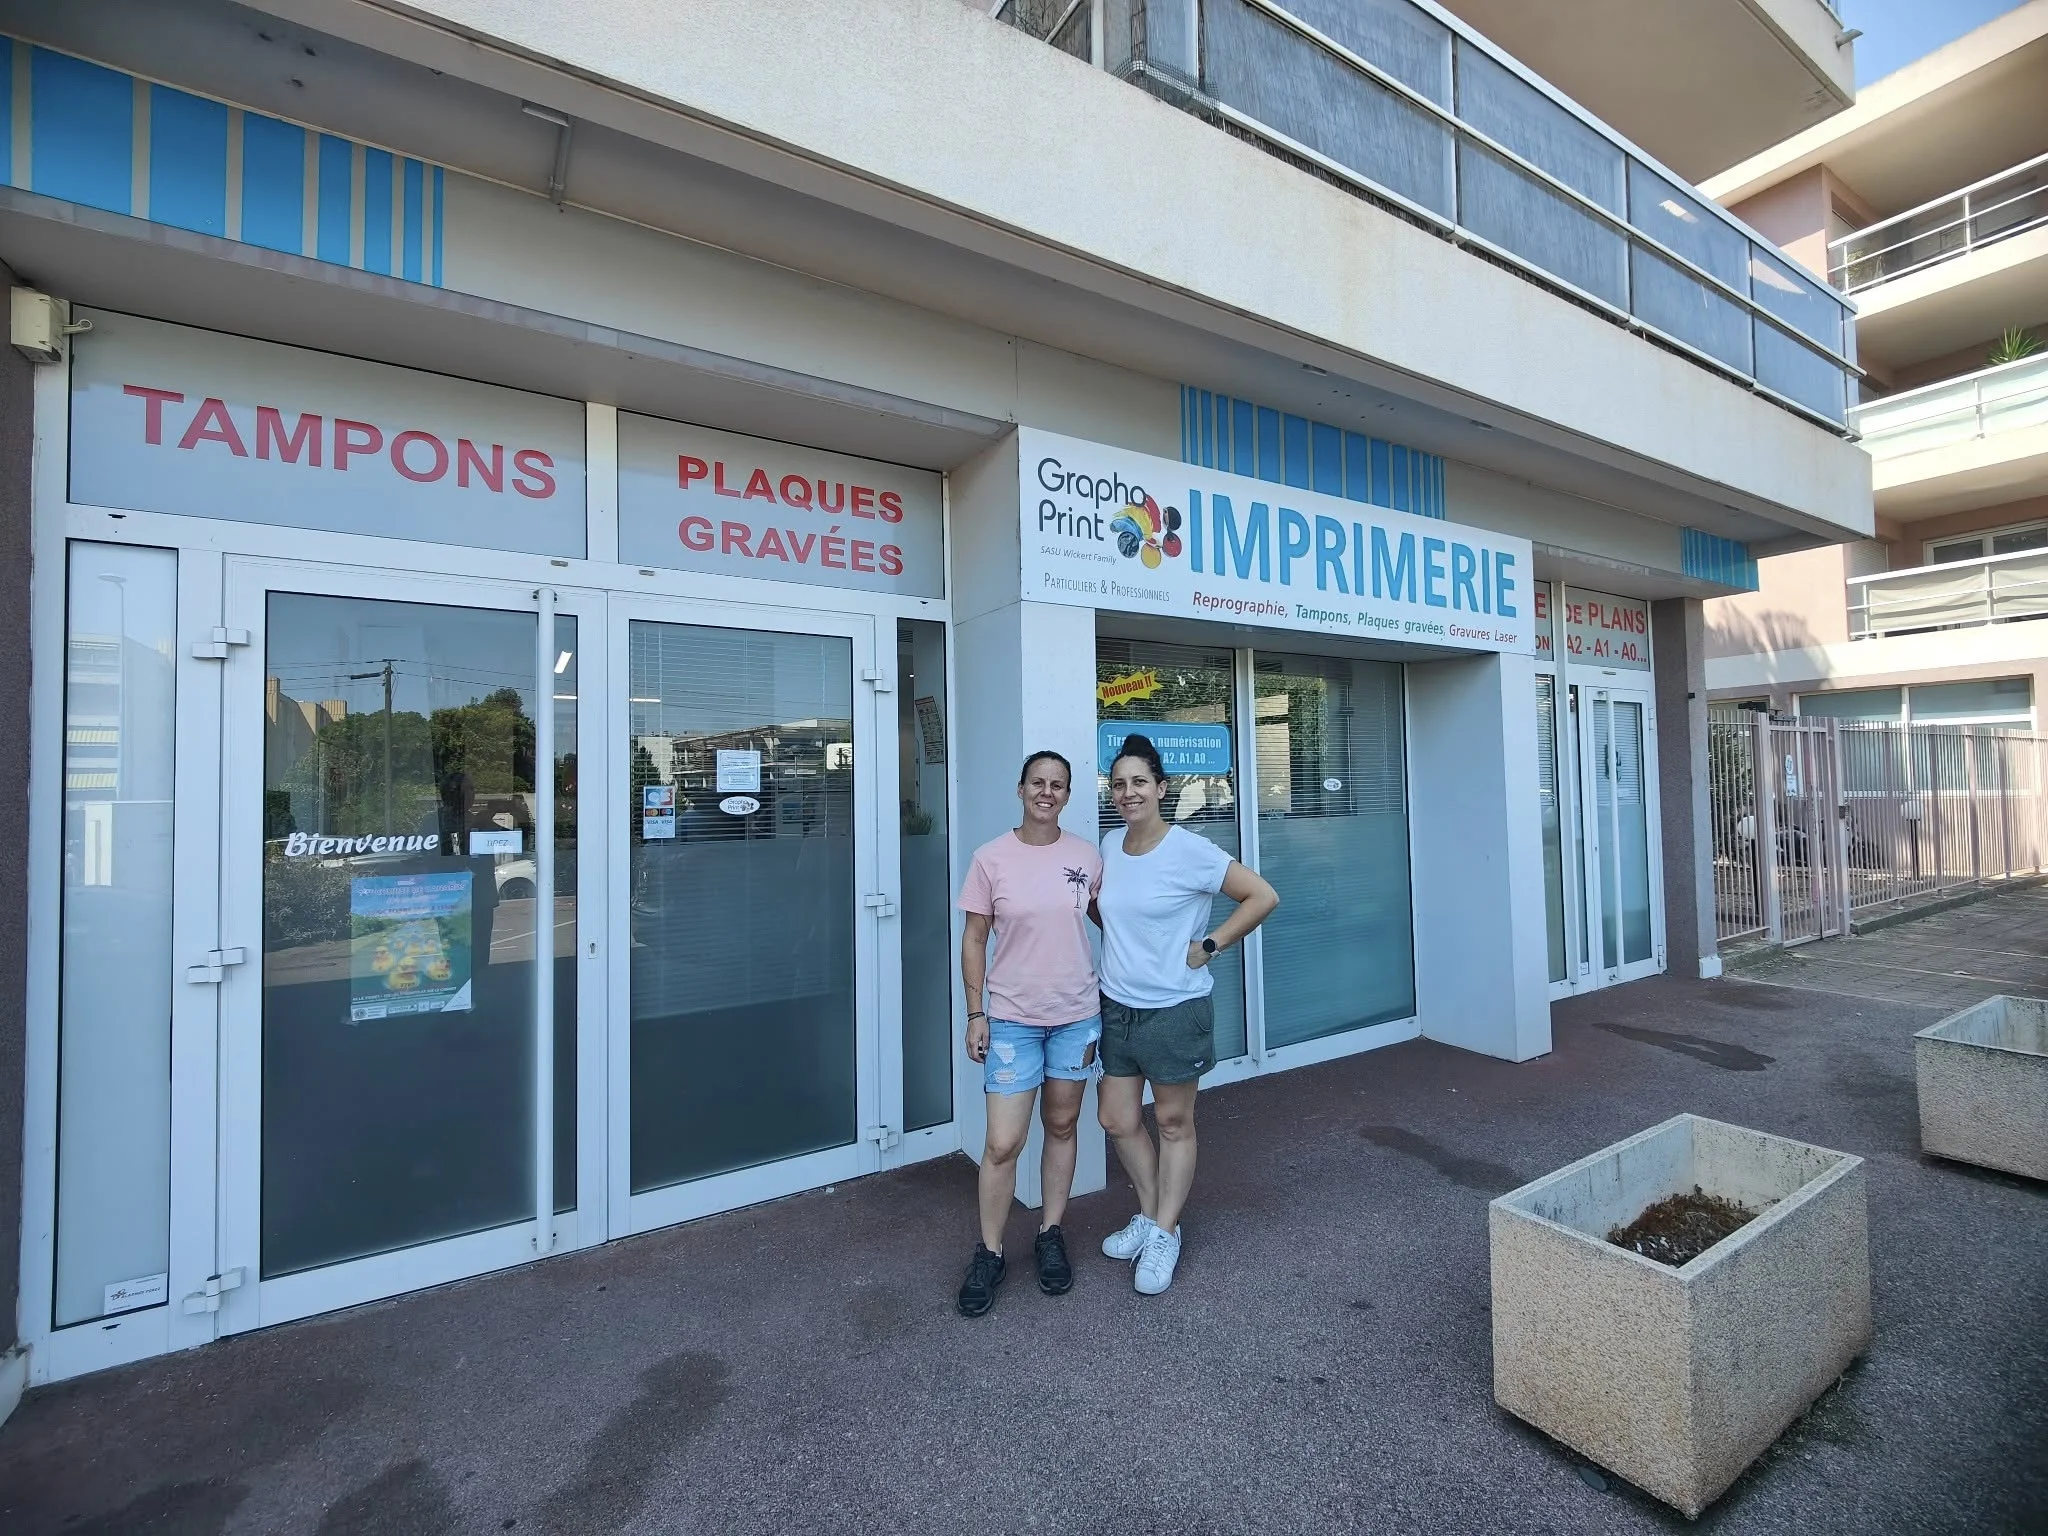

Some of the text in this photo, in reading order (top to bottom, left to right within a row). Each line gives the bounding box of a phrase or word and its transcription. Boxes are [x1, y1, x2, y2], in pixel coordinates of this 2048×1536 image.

[123, 384, 556, 499] TAMPONS
[678, 454, 904, 523] PLAQUES
[1037, 457, 1147, 509] Grapho
[1038, 499, 1105, 541] Print
[678, 516, 904, 576] GRAVÉES
[1040, 545, 1117, 565] SASU Wickert Family
[1189, 489, 1517, 618] IMPRIMERIE
[1100, 579, 1107, 594] &
[1192, 591, 1289, 618] Reprographie,
[1295, 604, 1352, 625] Tampons,
[1357, 612, 1399, 631] Plaques
[1404, 620, 1446, 636] gravées,
[1449, 624, 1490, 640] Gravures
[1494, 629, 1518, 644] Laser
[1588, 602, 1646, 634] PLANS
[1567, 634, 1582, 655] A2
[1593, 637, 1609, 657] A1
[1101, 679, 1144, 699] Nouveau
[1157, 735, 1222, 749] numérisation
[284, 831, 440, 857] Bienvenue
